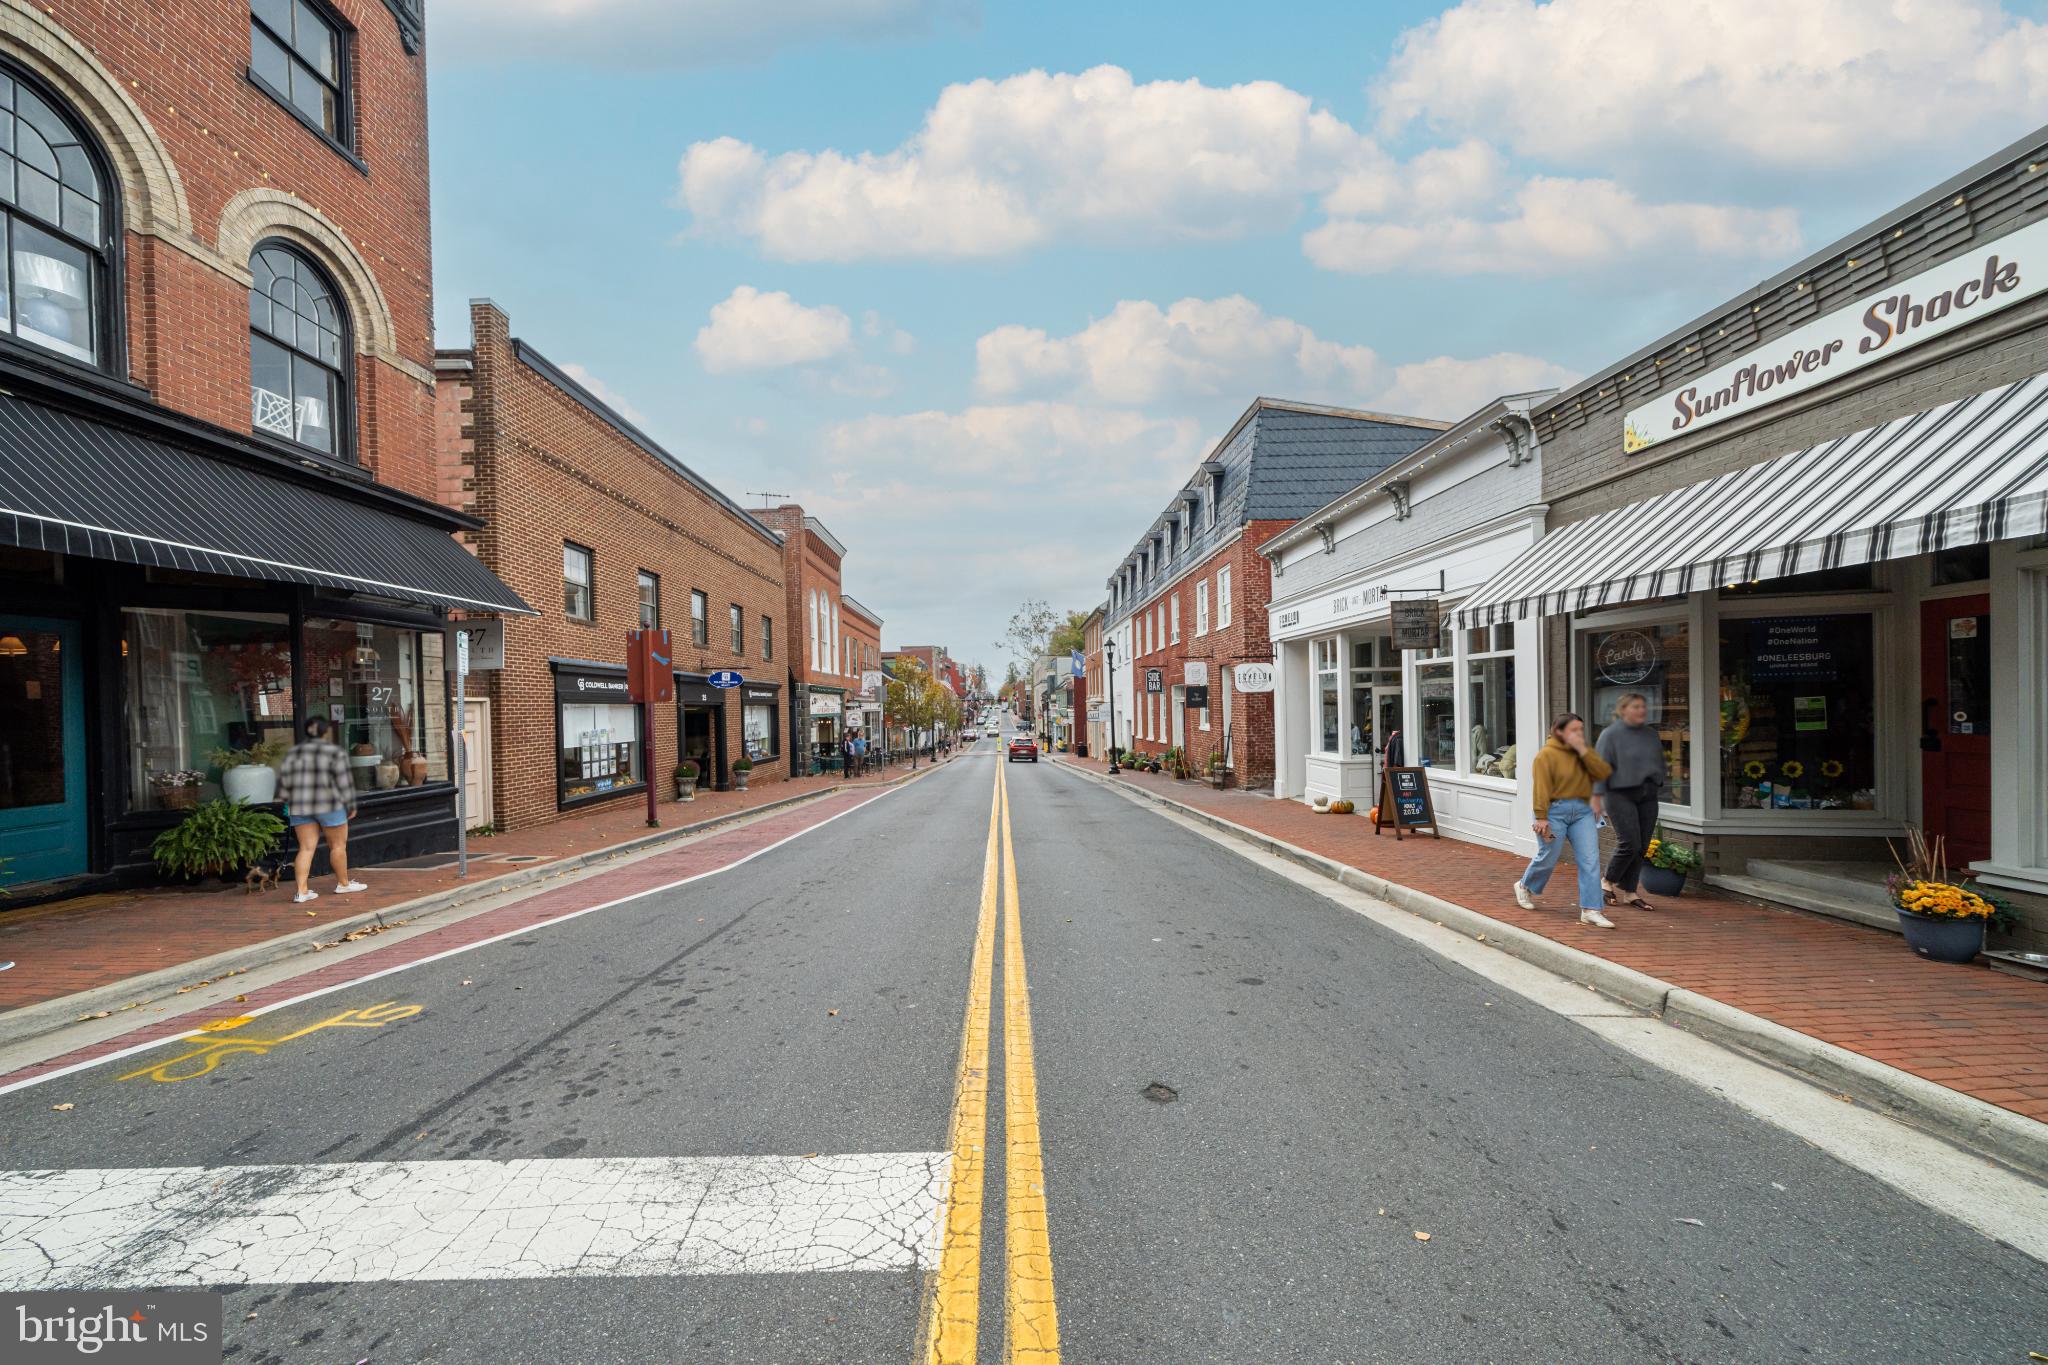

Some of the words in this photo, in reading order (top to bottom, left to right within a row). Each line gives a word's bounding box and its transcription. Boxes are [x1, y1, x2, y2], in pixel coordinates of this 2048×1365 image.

[1672, 338, 1843, 431] Sunflower
[1858, 255, 2021, 355] Shack
[1333, 596, 1349, 614] BRICK
[1363, 585, 1388, 606] MORTAR
[1404, 607, 1425, 618] BRICK
[1769, 625, 1817, 634] #OneWorld
[1767, 638, 1819, 646] #OneNation
[1757, 652, 1832, 662] #ONELEESBURG
[1148, 672, 1161, 682] SIDE
[585, 681, 608, 689] COLDWELL
[1148, 681, 1161, 691] BAR
[372, 686, 393, 705] 27
